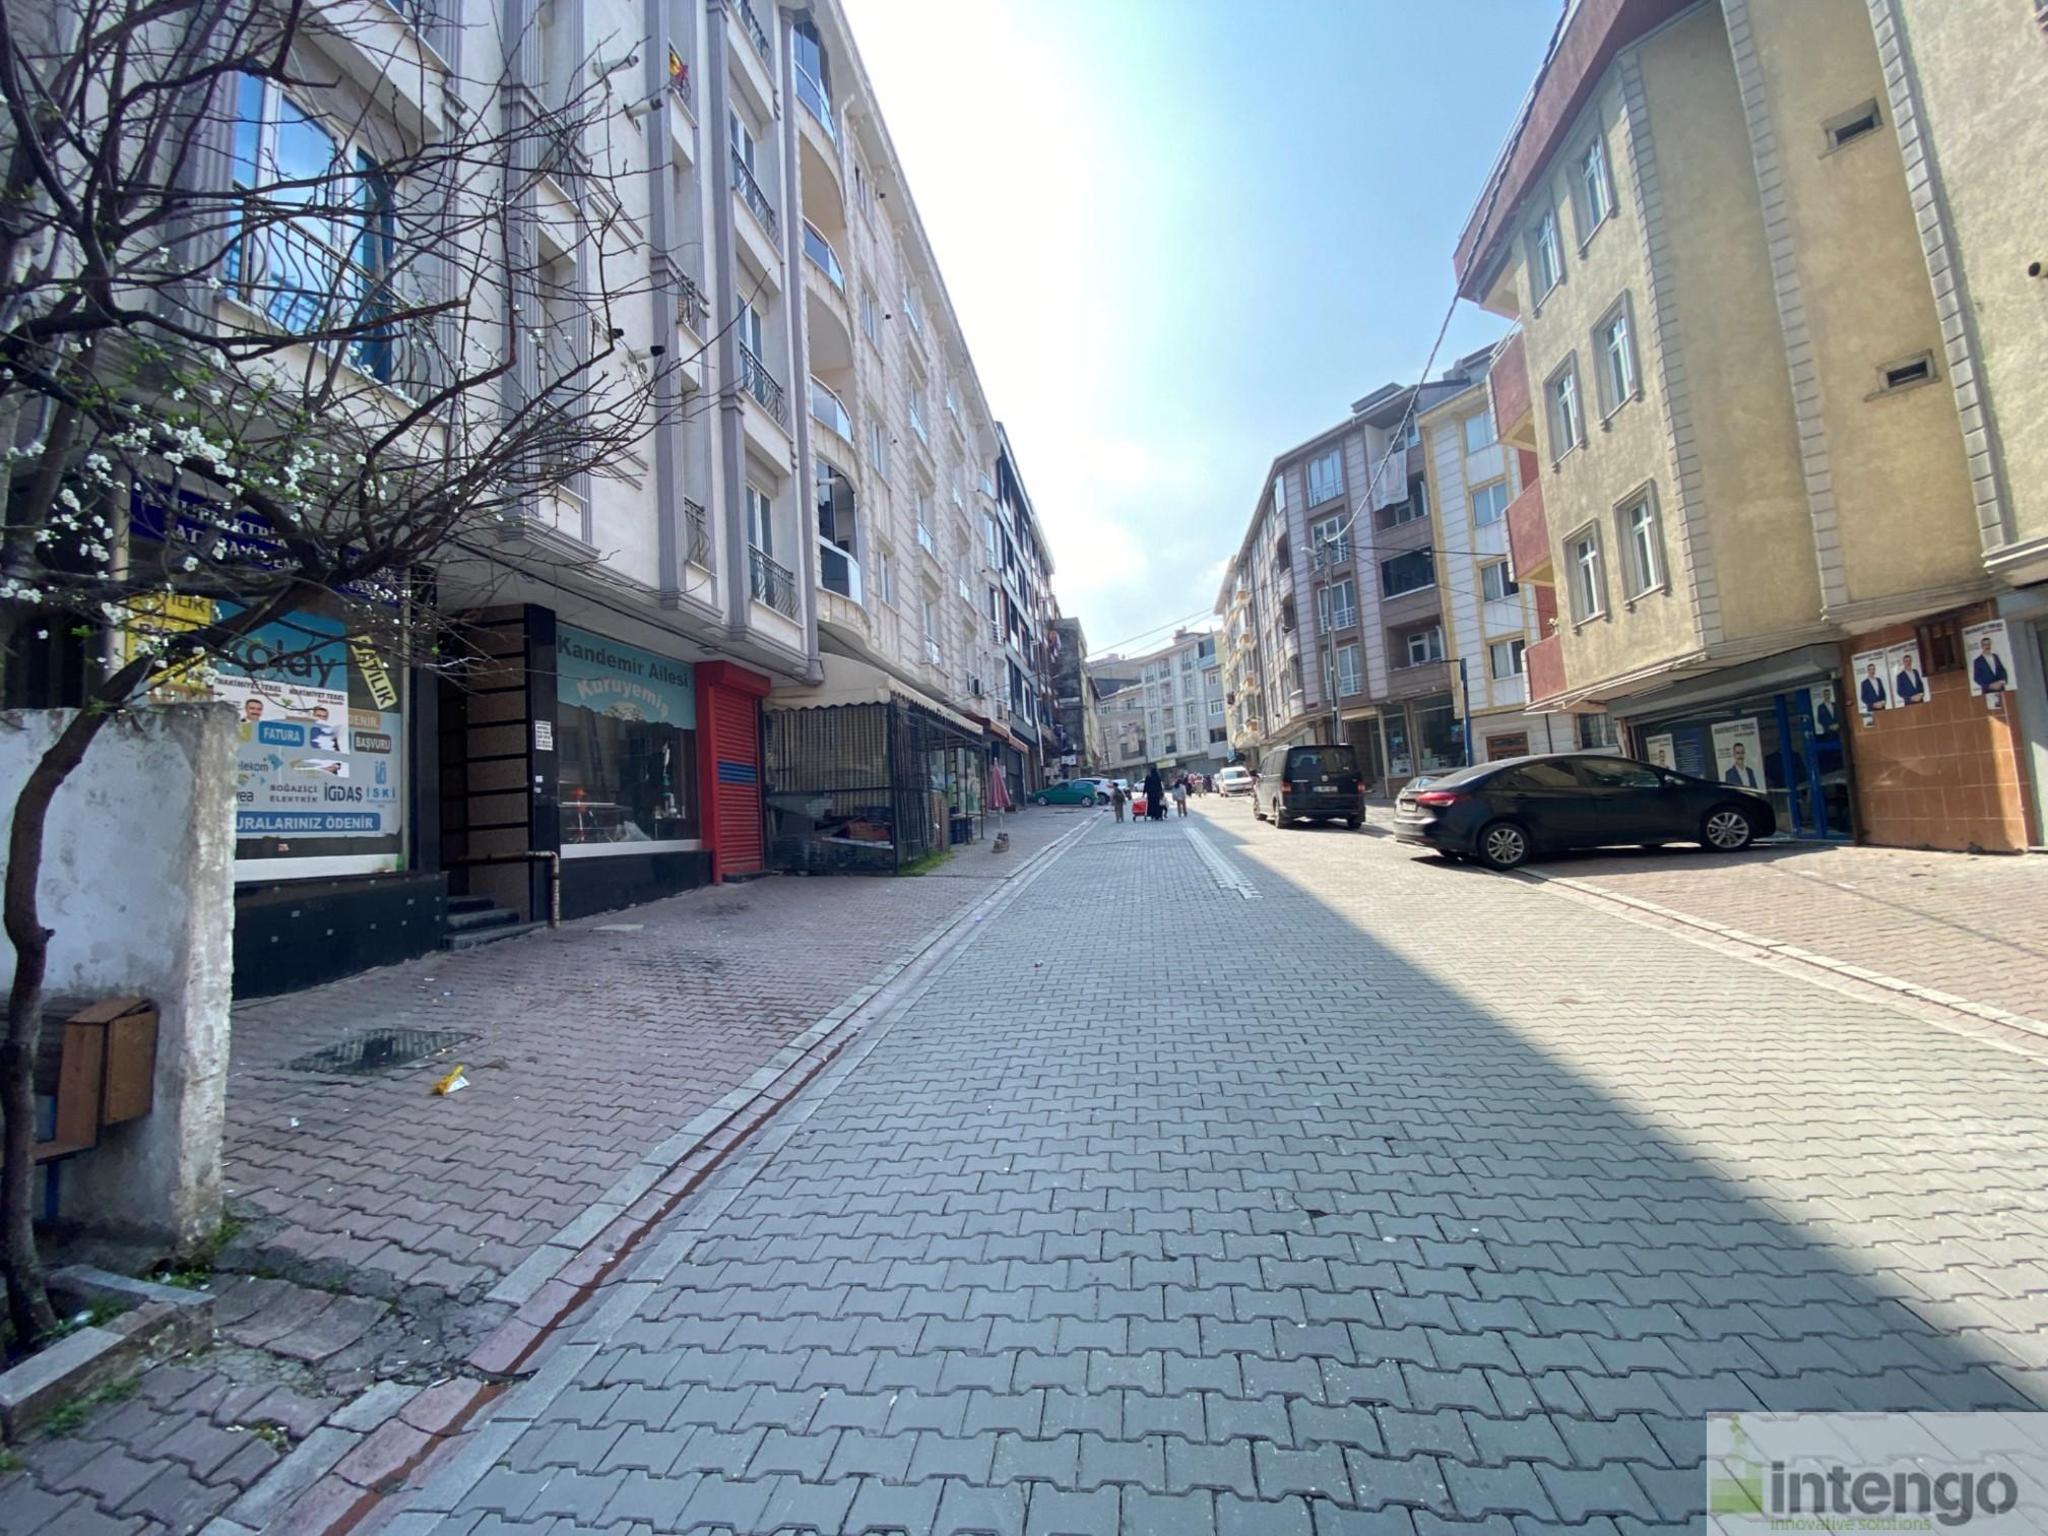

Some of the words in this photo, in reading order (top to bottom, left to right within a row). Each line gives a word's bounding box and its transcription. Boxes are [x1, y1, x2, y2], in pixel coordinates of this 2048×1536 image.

[557, 634, 644, 677] Kandemir
[648, 662, 688, 688] Ailesi
[263, 727, 300, 742] FATURA
[355, 736, 390, 751] BAŞVURU
[270, 783, 318, 794] BOĞAZİÇİ
[324, 782, 363, 805] İGDAŞ
[270, 795, 318, 803] ELEKTRİK
[326, 814, 374, 830] ÖDENİR
